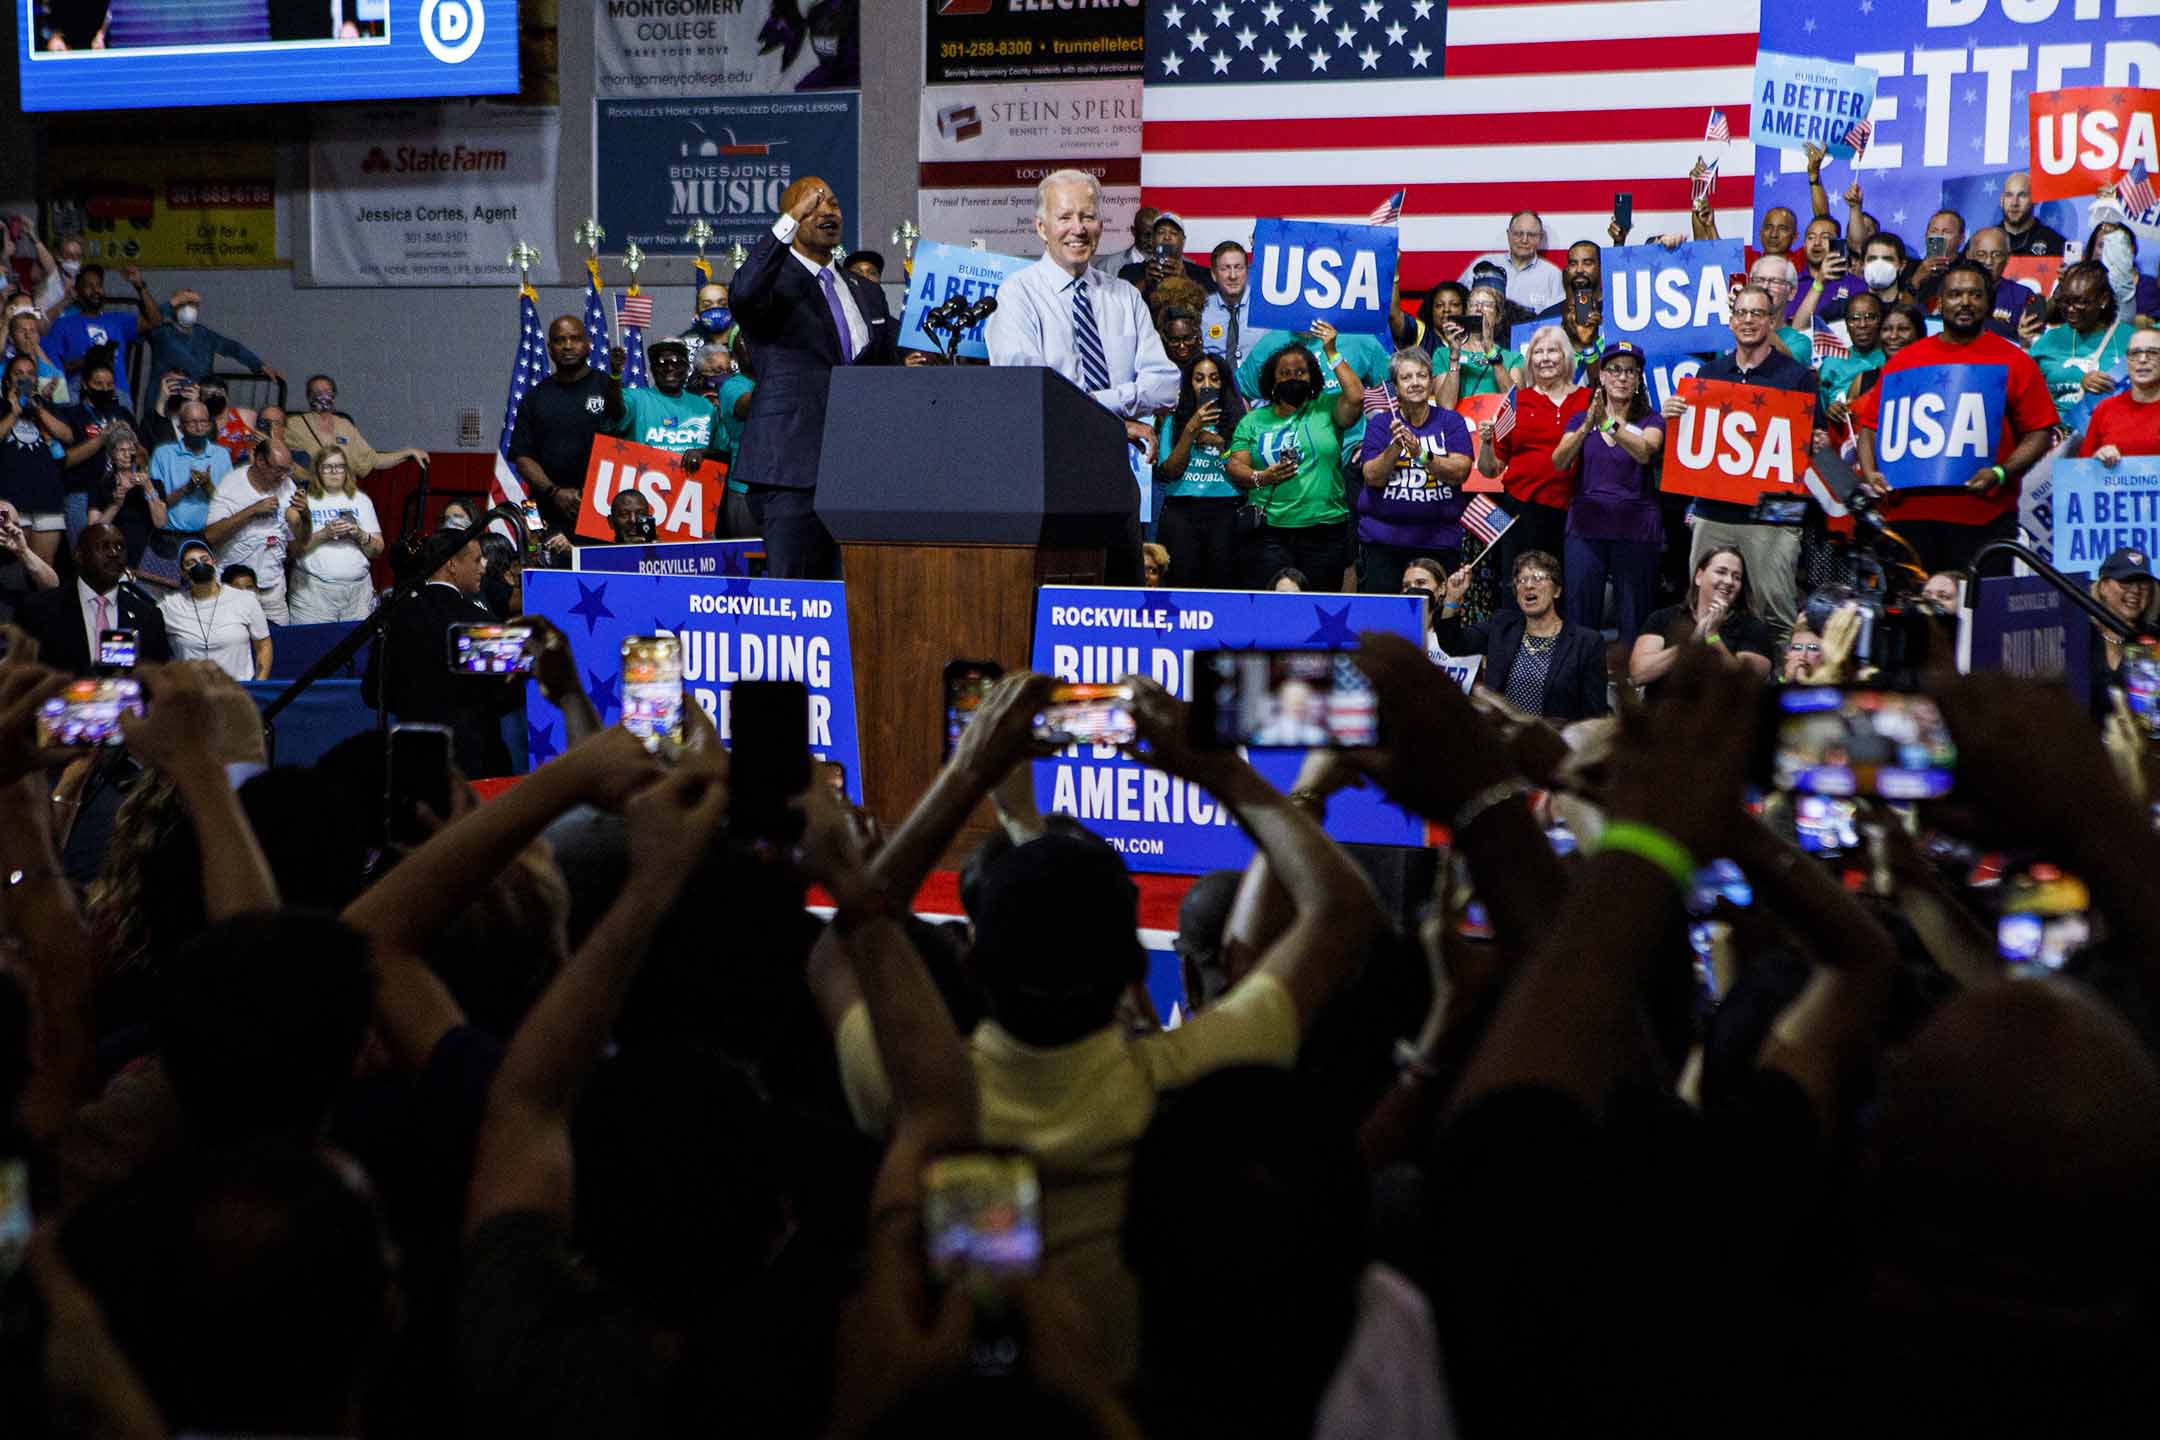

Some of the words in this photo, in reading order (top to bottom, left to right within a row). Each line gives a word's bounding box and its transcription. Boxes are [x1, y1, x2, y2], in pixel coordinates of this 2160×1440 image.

[608, 0, 743, 18] MONTGOMERY
[637, 22, 717, 41] COLLEGE
[697, 46, 728, 56] MOVE
[940, 40, 1032, 57] 301-258-8300
[944, 69, 968, 79] Serving
[970, 68, 1007, 78] Montgomery
[1009, 67, 1031, 77] County
[1062, 66, 1076, 74] with
[1795, 72, 1838, 85] BUILDING
[771, 103, 803, 114] GUITAR
[805, 102, 848, 113] LESSONS
[1762, 80, 1775, 105] A
[1783, 83, 1864, 118] BETTER
[991, 100, 1060, 122] STEIN
[1072, 98, 1142, 121] SPERL
[1009, 127, 1048, 136] BENNETT
[1061, 127, 1072, 136] DE
[1074, 126, 1099, 136] JONG
[2037, 110, 2159, 174] USA
[670, 164, 791, 177] BONESJONES
[671, 178, 791, 215] MUSIC
[932, 196, 959, 206] Proud
[961, 196, 990, 206] Parent
[992, 196, 1008, 206] and
[357, 208, 412, 223] Jessica
[416, 206, 468, 223] Cortes,
[473, 205, 517, 224] Agent
[958, 264, 1004, 281] BUILDING
[1261, 245, 1380, 312] USA
[920, 272, 935, 302] A
[1612, 264, 1731, 333] USA
[645, 427, 711, 446] AFSCME
[1881, 392, 1990, 462] USA
[1676, 404, 1794, 484] USA
[2104, 474, 2158, 486] BUILDING
[592, 459, 704, 538] USA
[1383, 486, 1453, 502] HARRIS
[2066, 491, 2084, 524] A
[638, 558, 698, 575] ROCKVILLE,
[700, 557, 716, 573] MD
[689, 594, 797, 620] ROCKVILLE,
[802, 599, 832, 618] MD
[1051, 606, 1173, 632] ROCKVILLE,
[1179, 610, 1214, 630] MD
